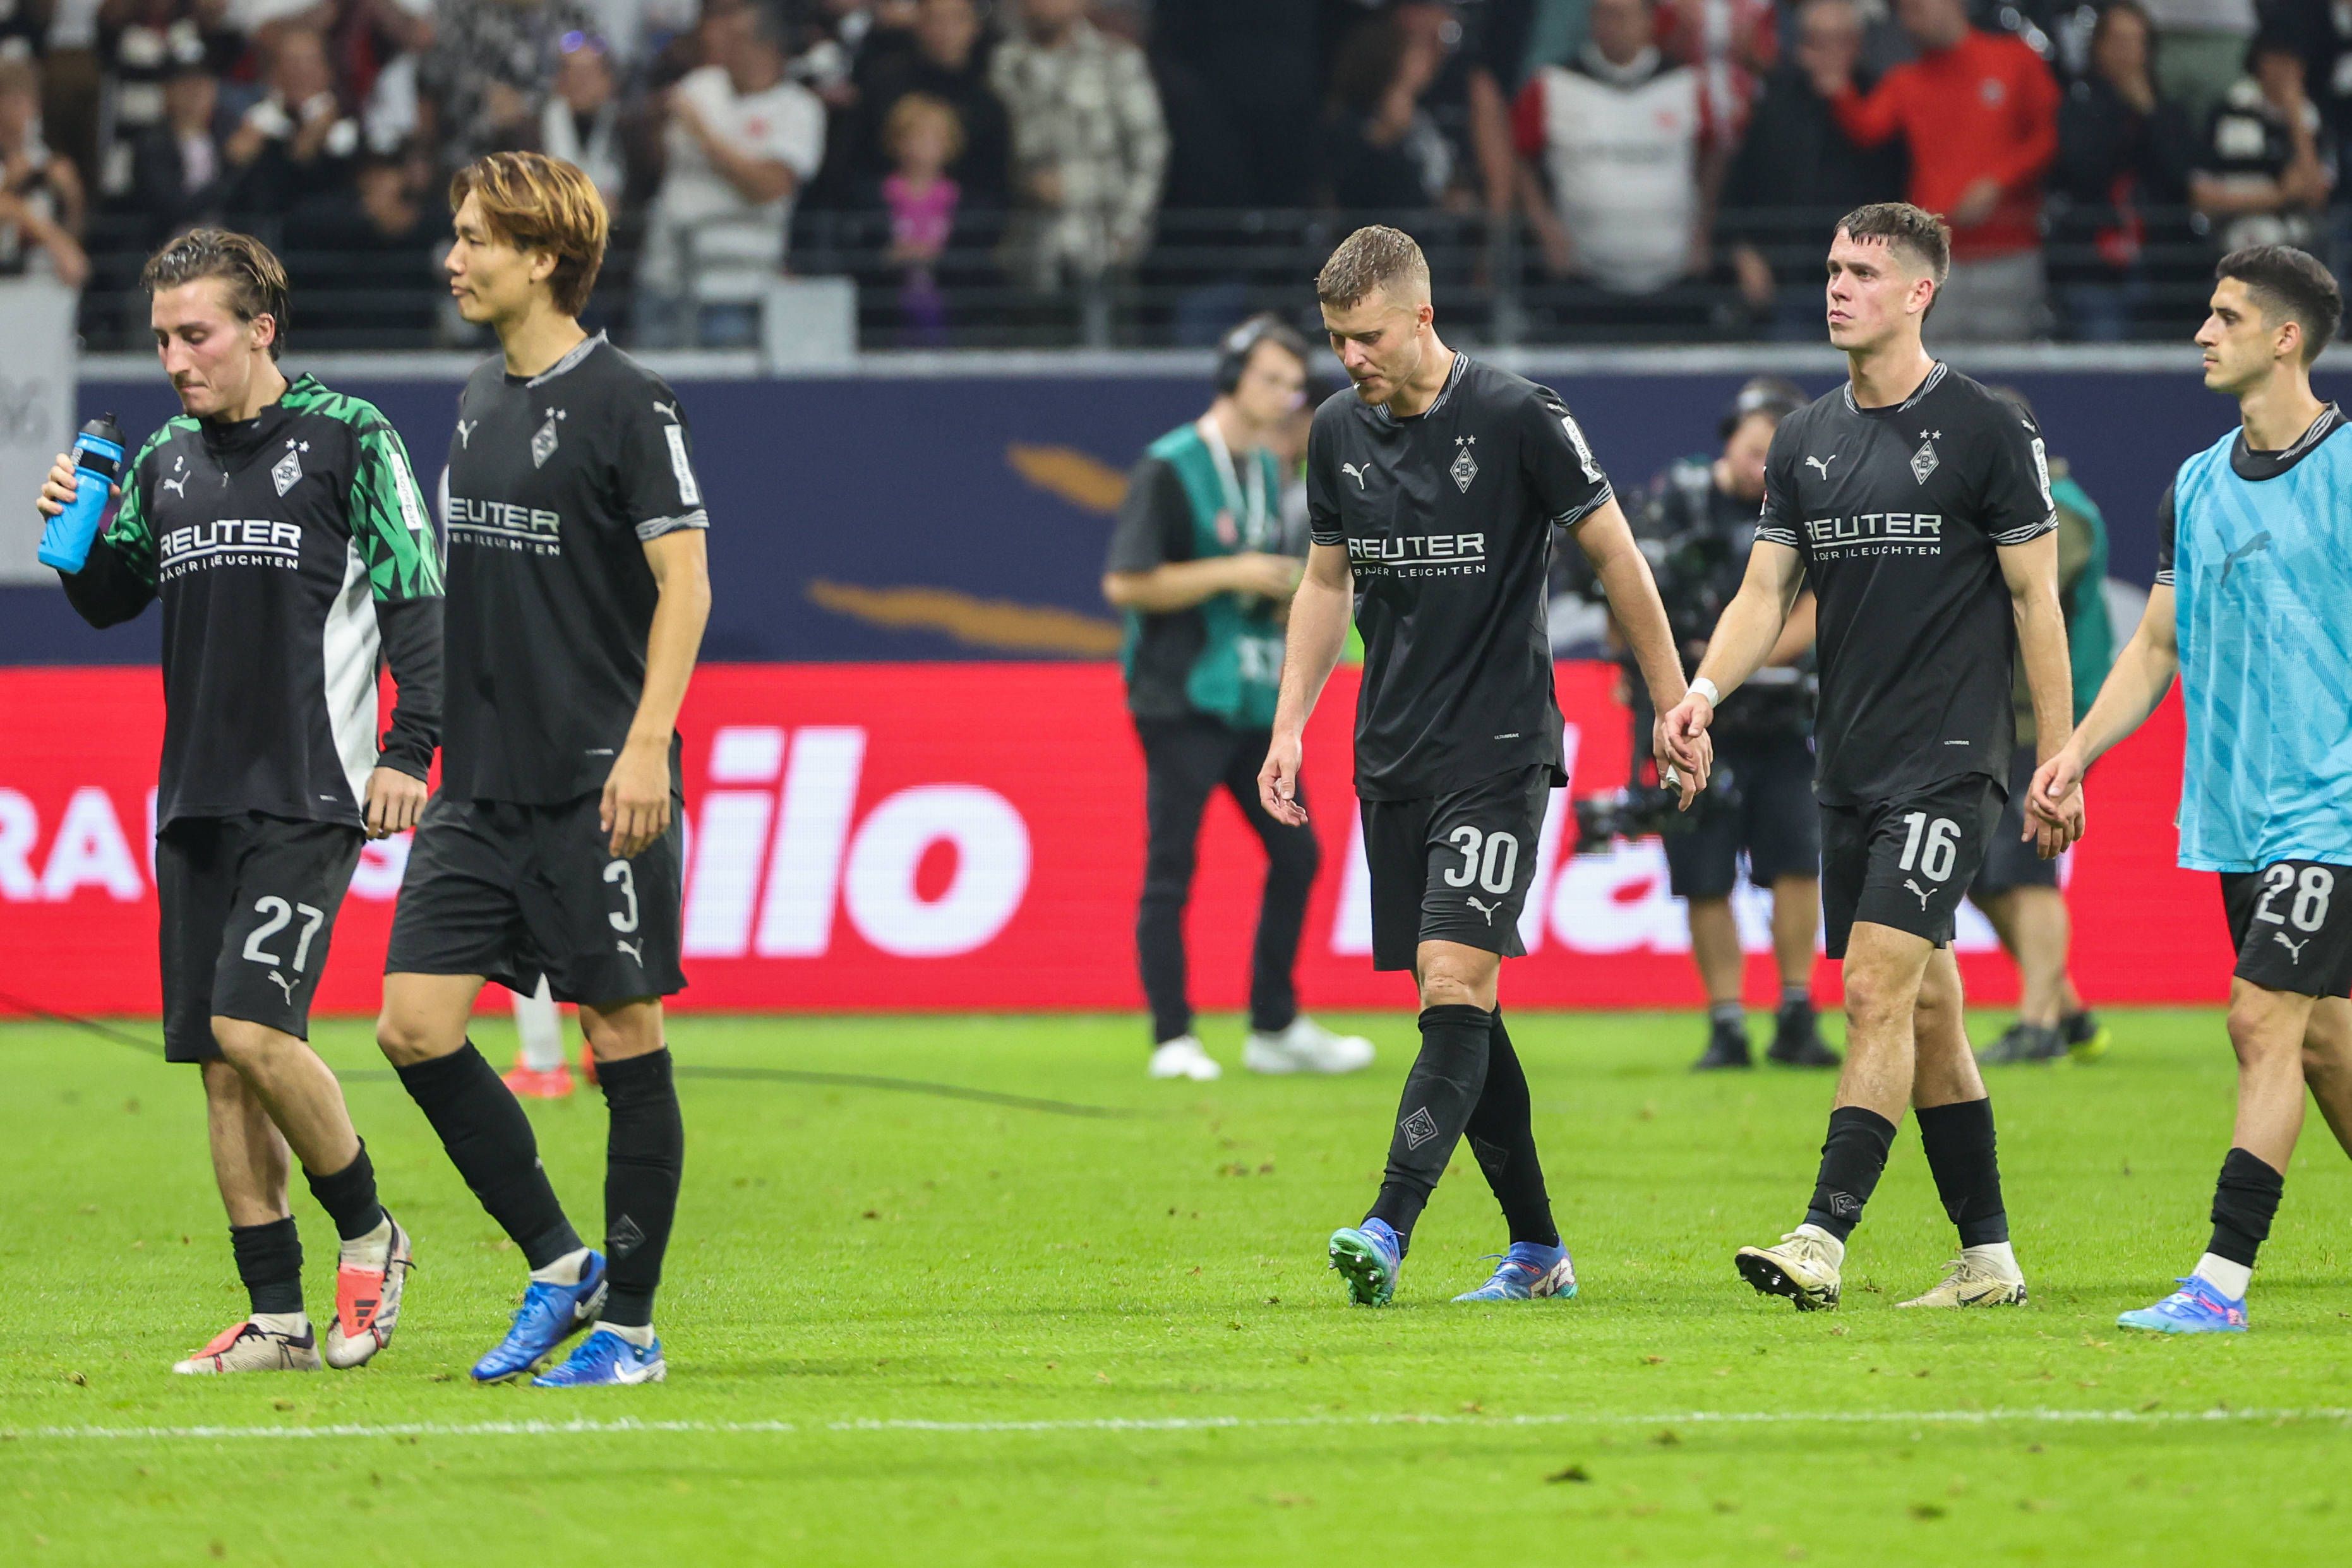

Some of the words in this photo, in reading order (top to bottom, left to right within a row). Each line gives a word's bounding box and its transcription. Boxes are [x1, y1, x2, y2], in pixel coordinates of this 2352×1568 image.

[160, 519, 302, 558] REUTER
[1347, 532, 1485, 559] REUTER
[1804, 513, 1942, 541] REUTER
[1850, 546, 1941, 558] LEUCHTEN
[1398, 565, 1485, 578] LEUCHTEN
[681, 725, 1034, 958] ilo
[1443, 825, 1519, 894] 30
[1899, 811, 1962, 883] 16
[603, 858, 639, 933] 3
[2255, 863, 2335, 932] 28
[242, 895, 325, 973] 27
